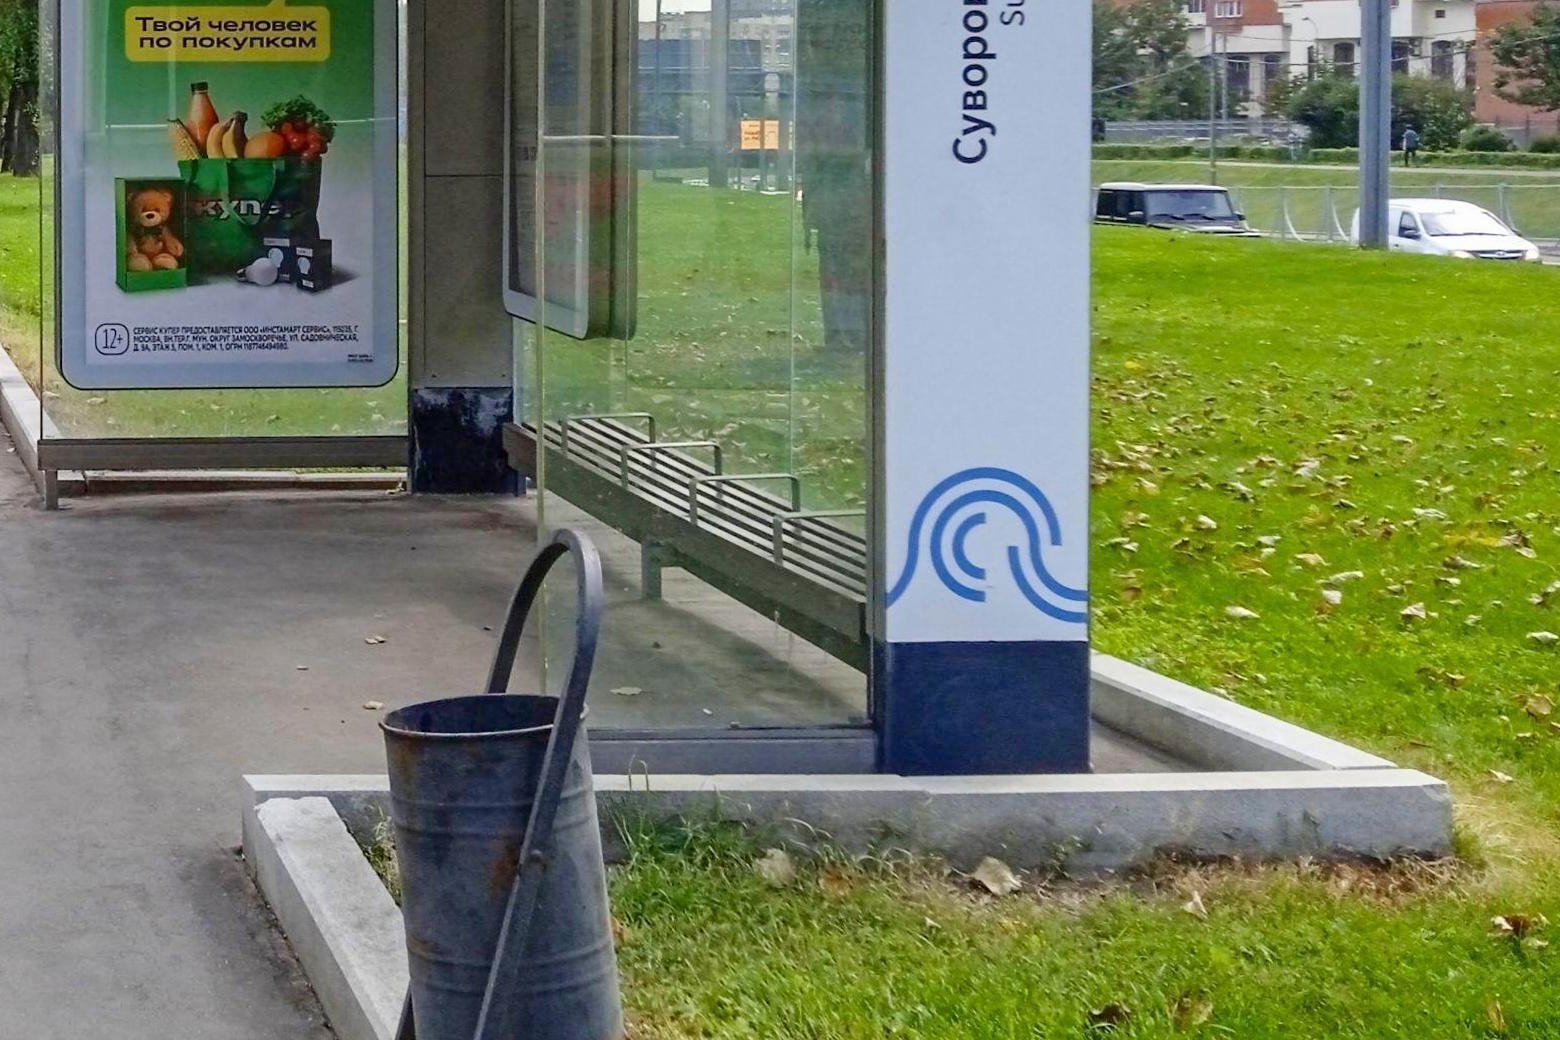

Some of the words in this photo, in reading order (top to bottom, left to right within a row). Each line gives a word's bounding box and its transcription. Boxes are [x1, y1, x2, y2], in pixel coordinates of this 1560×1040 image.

[134, 17, 201, 32] Твой
[207, 19, 318, 32] человек
[139, 36, 172, 48] по
[182, 36, 317, 51] покупкам
[243, 326, 258, 334] ООО
[102, 328, 123, 349] 12+
